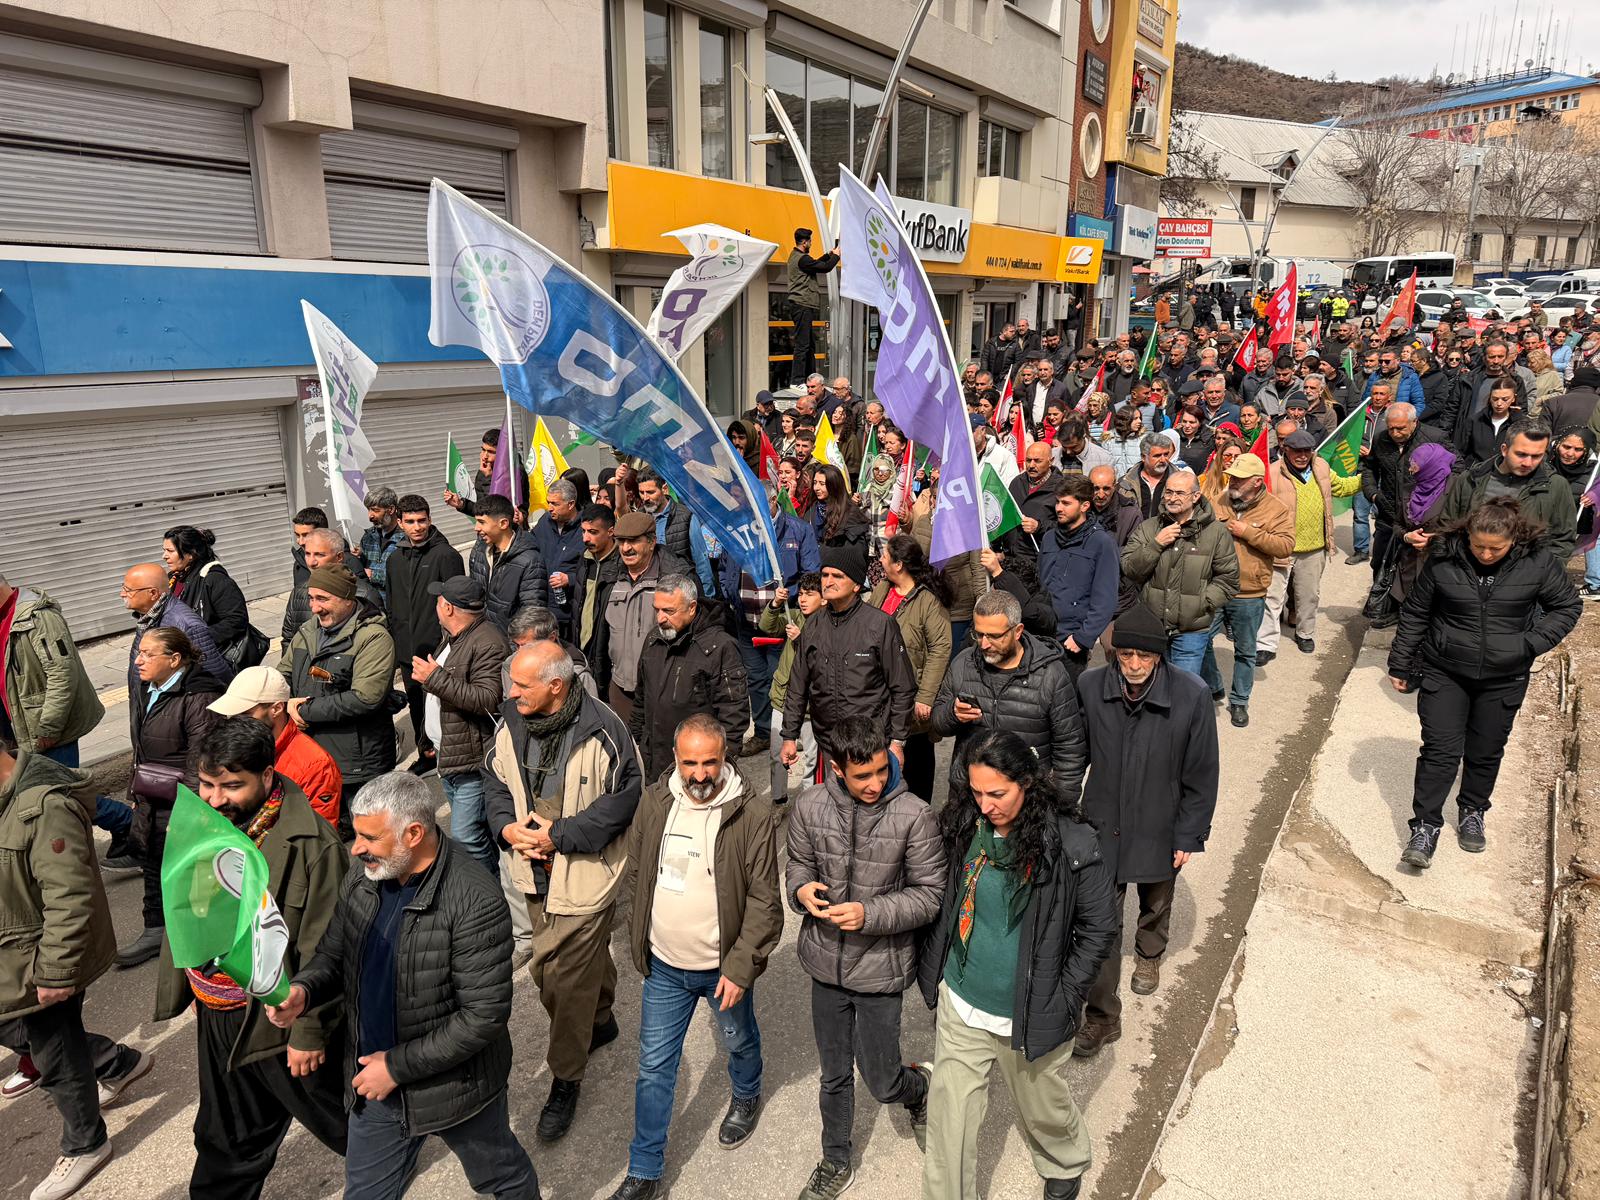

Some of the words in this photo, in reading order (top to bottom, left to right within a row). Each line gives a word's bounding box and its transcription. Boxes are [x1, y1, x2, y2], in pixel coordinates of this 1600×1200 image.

[902, 210, 968, 252] kıfBank
[1159, 222, 1174, 234] ÇAY
[1176, 222, 1208, 235] BAHÇESİ
[688, 850, 701, 858] VIEW
